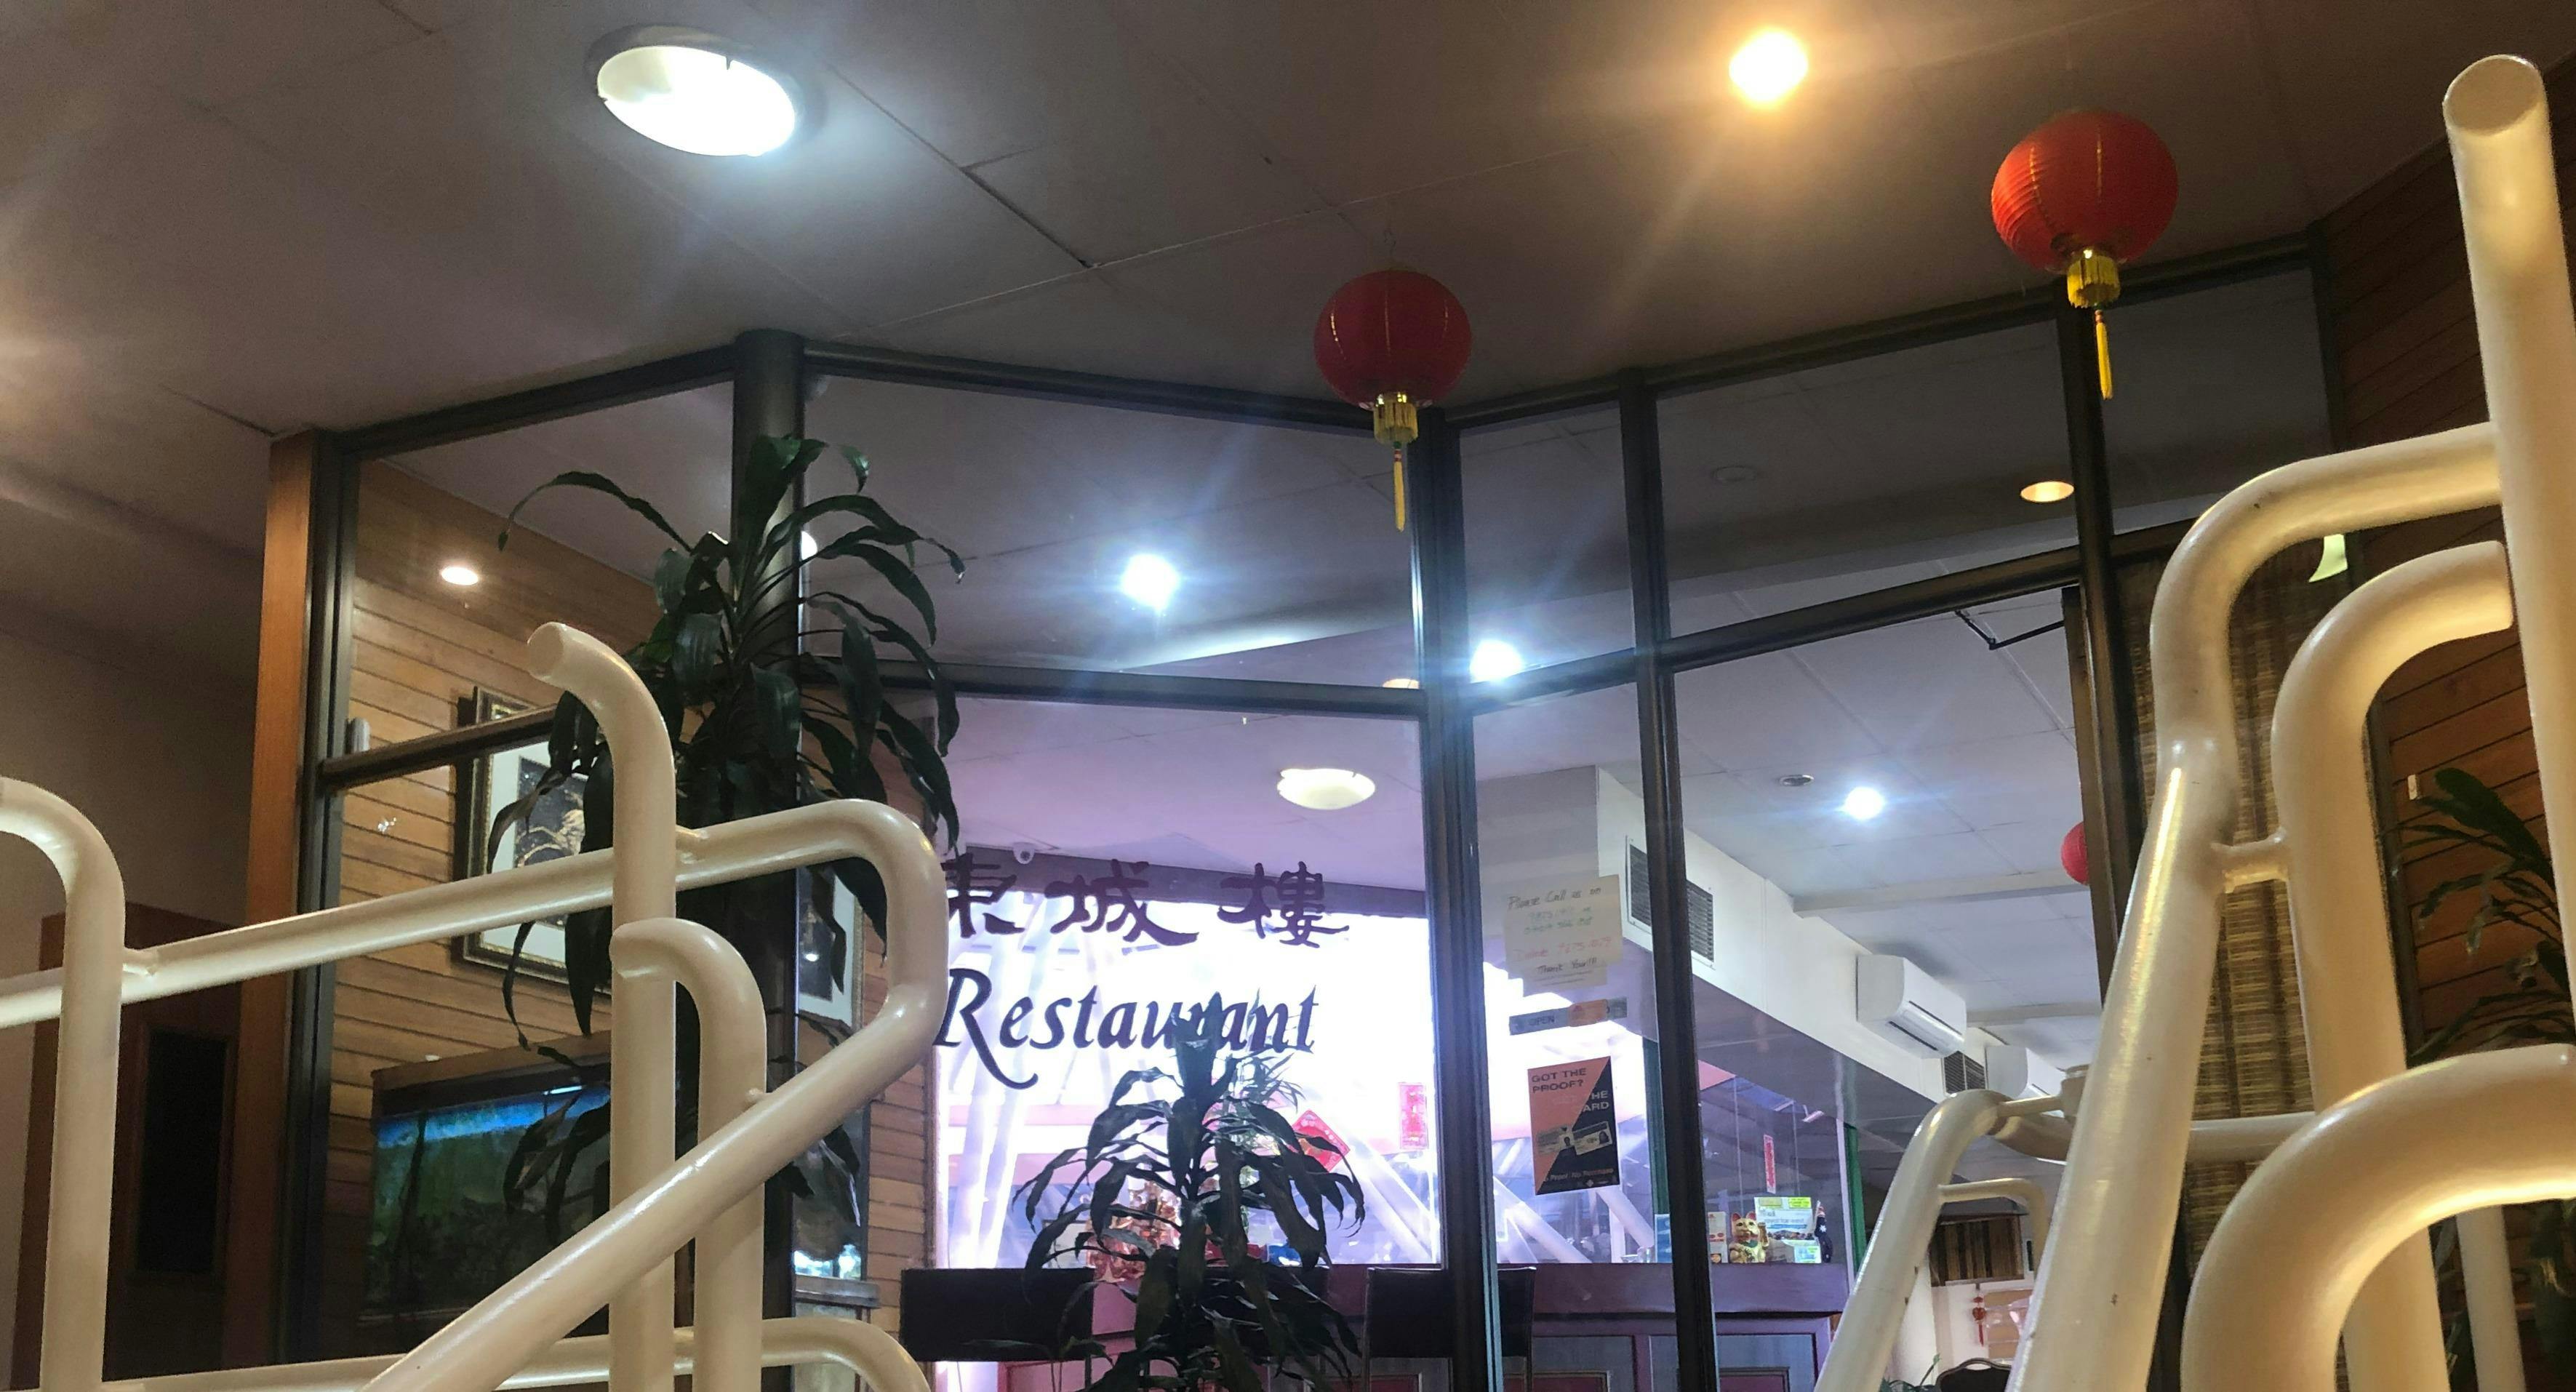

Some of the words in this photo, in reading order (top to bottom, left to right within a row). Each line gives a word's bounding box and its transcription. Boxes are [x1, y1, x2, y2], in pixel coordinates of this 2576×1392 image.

[1545, 889, 1567, 903] Call
[1536, 964, 1564, 975] Thank
[1528, 1016, 1556, 1026] OPEN
[934, 968, 1319, 1089] Restaurant
[1532, 1072, 1558, 1083] GOT
[1562, 1068, 1587, 1078] THE
[1532, 1079, 1584, 1093] PROOF?
